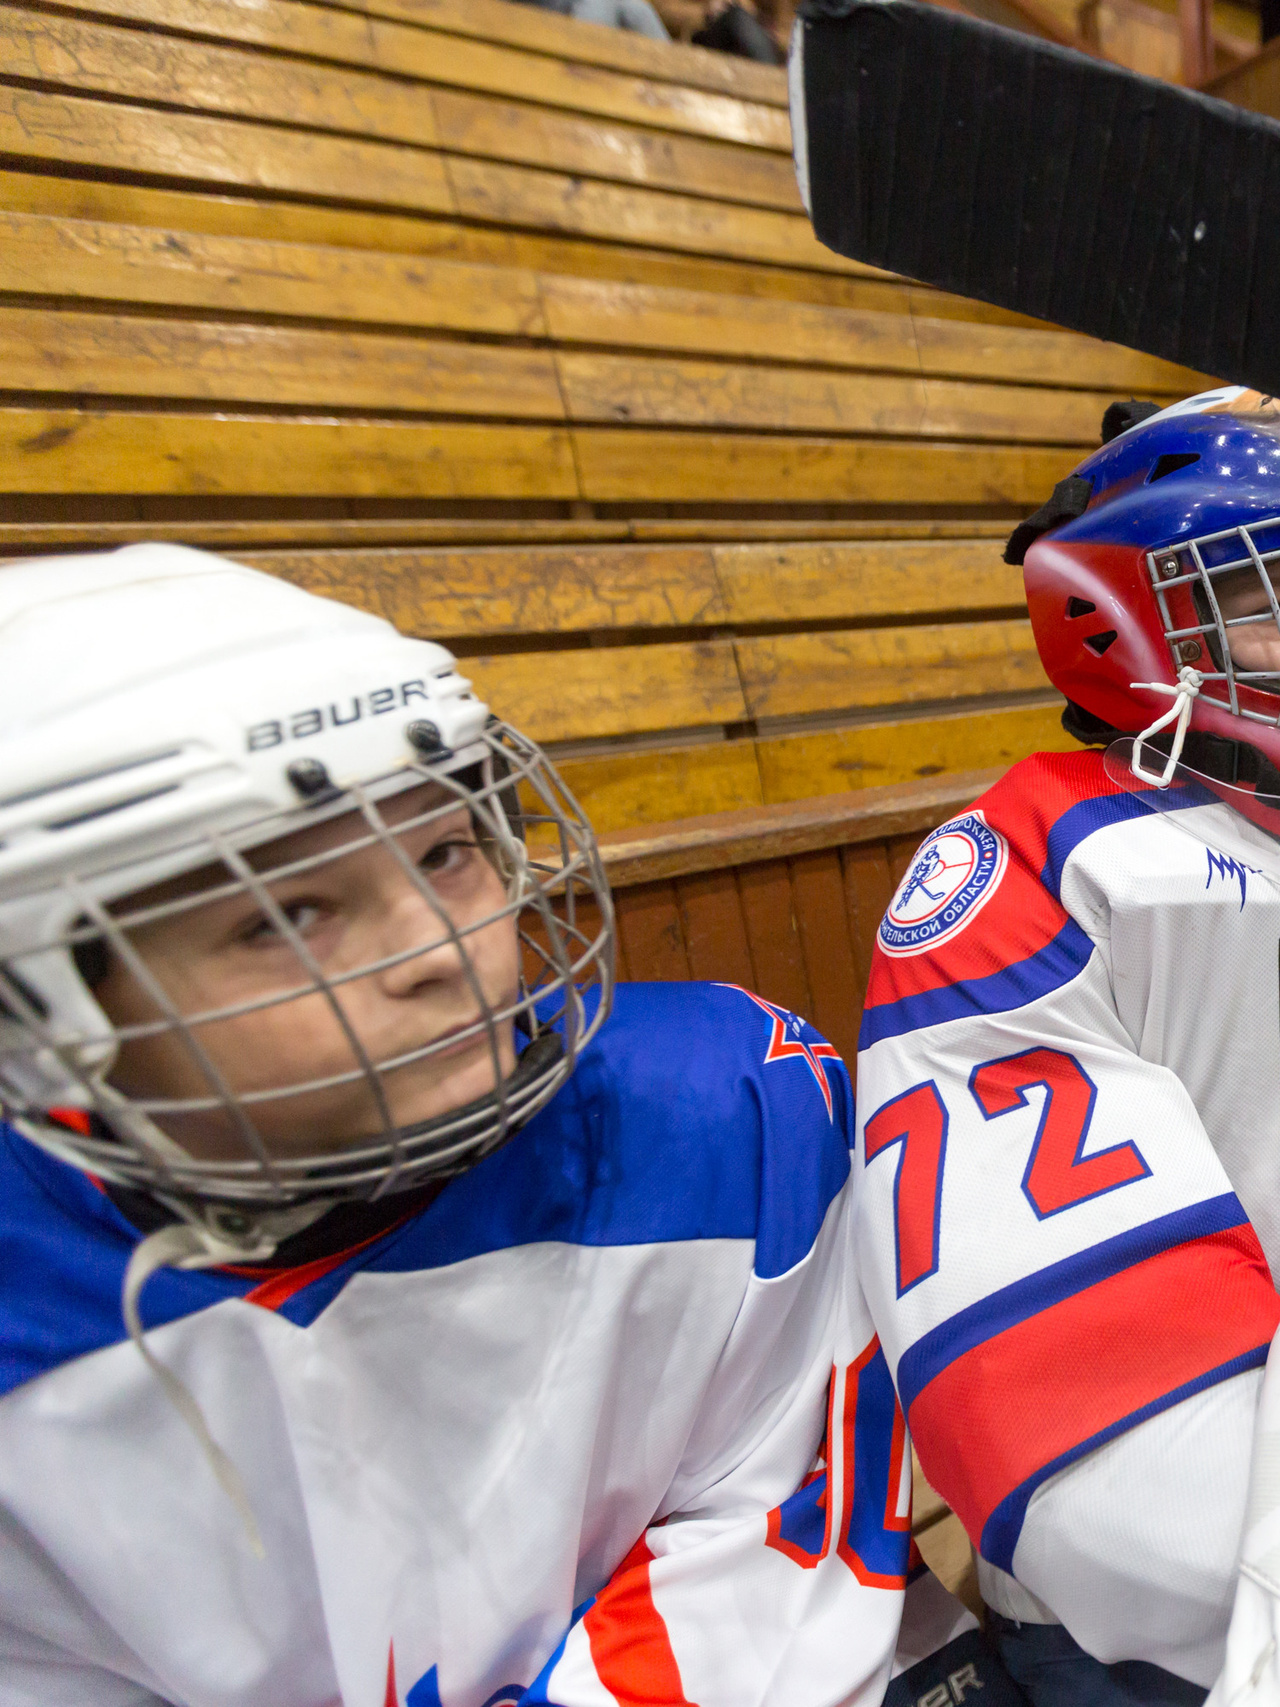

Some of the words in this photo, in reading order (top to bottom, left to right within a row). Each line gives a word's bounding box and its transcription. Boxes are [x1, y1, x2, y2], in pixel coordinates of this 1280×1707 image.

[246, 679, 429, 753] BAUER
[963, 817, 995, 851] ОККЕЯ
[943, 859, 993, 922] ОБЛАСТИ
[864, 1045, 1154, 1300] 72
